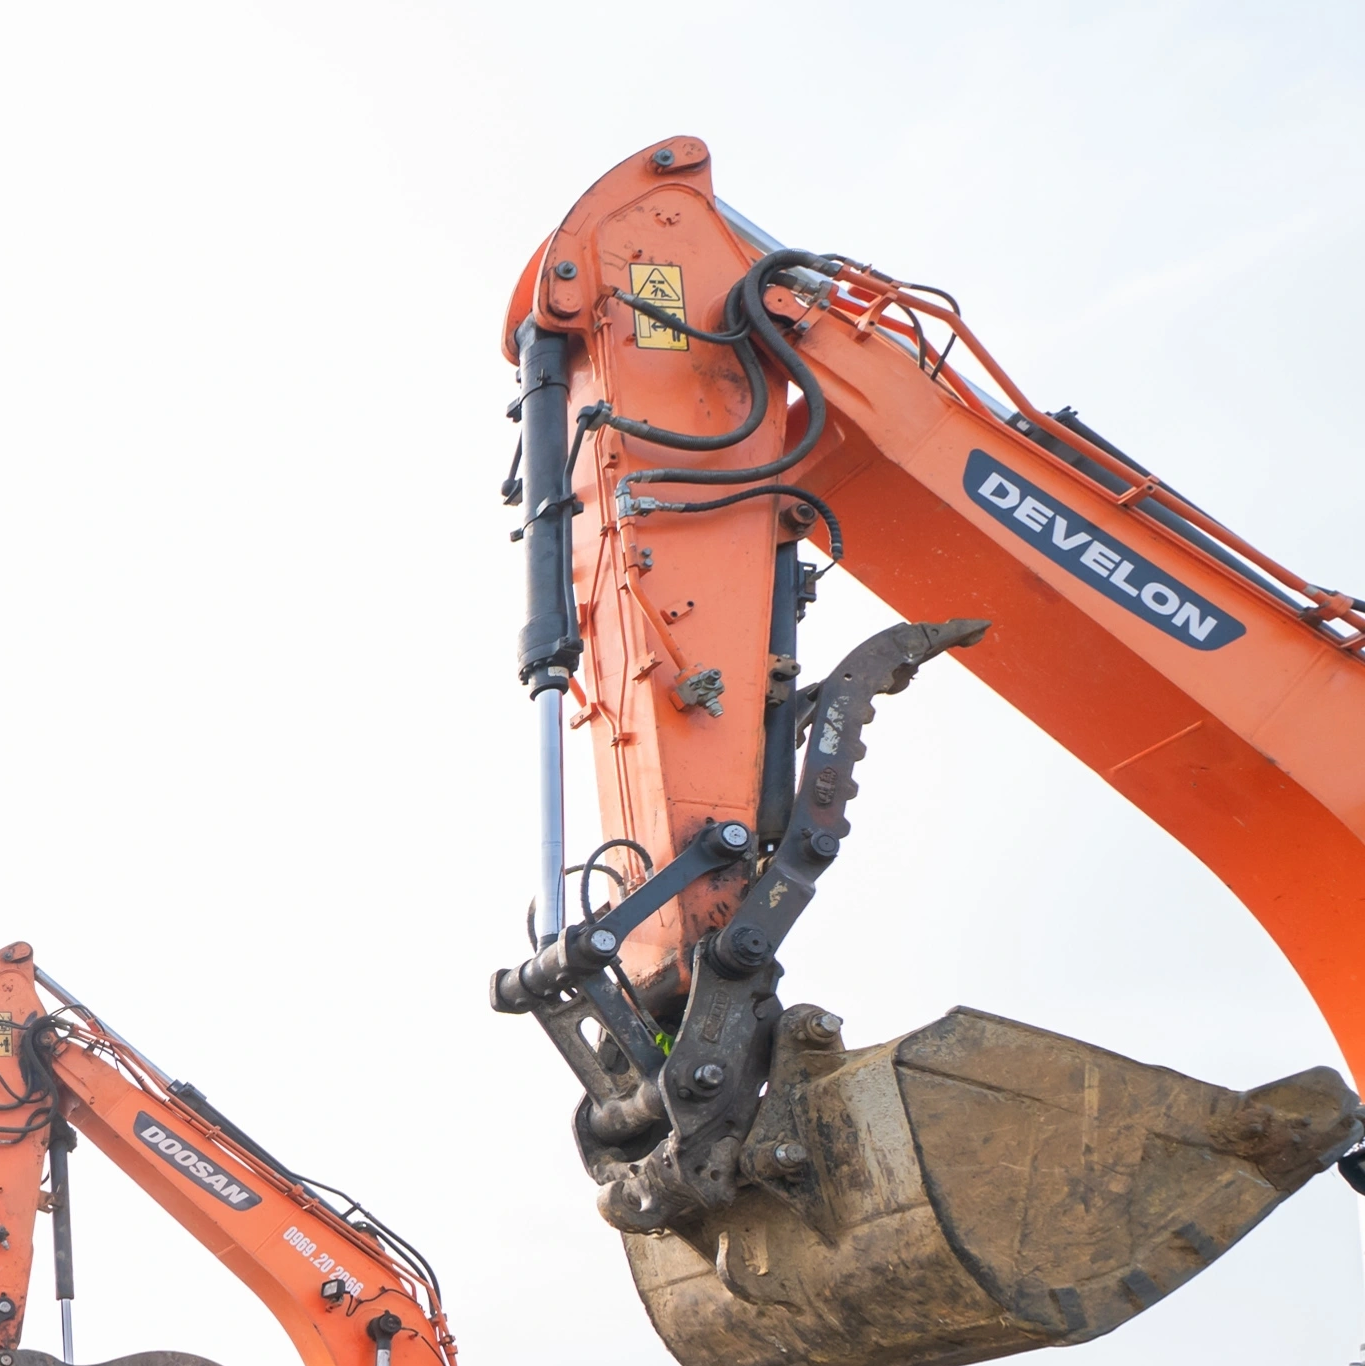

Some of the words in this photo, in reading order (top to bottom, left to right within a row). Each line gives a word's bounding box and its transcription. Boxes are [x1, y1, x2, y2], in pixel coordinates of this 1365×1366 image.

[977, 472, 1218, 642] DEVELON
[140, 1125, 249, 1204] DOOSAN
[283, 1226, 335, 1273] 0969.20
